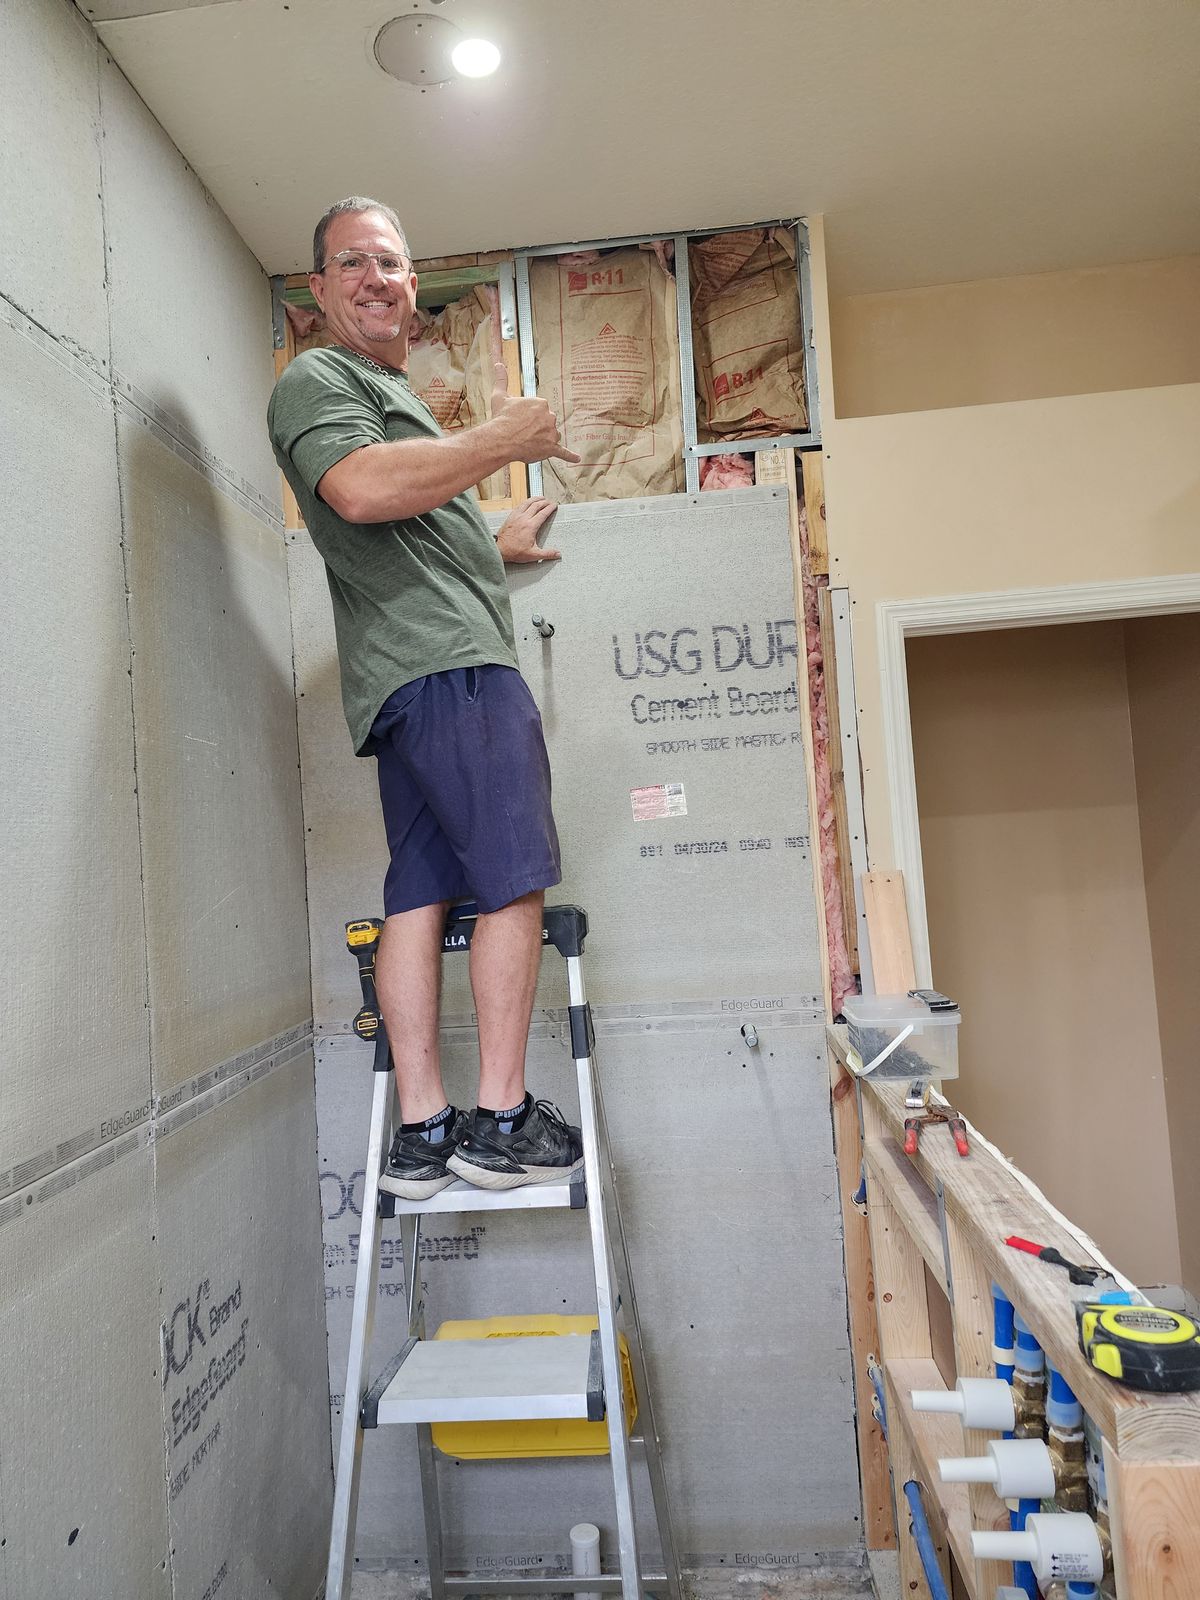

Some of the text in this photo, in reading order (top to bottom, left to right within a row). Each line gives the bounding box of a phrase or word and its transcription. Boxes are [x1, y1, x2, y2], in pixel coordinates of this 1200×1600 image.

[612, 628, 702, 681] USG
[630, 681, 798, 724] Cement Board
[721, 998, 784, 1011] EdgeGuard
[494, 1102, 526, 1119] PUMA
[209, 1281, 242, 1337] Brand
[734, 1552, 800, 1566] EdgeGuard
